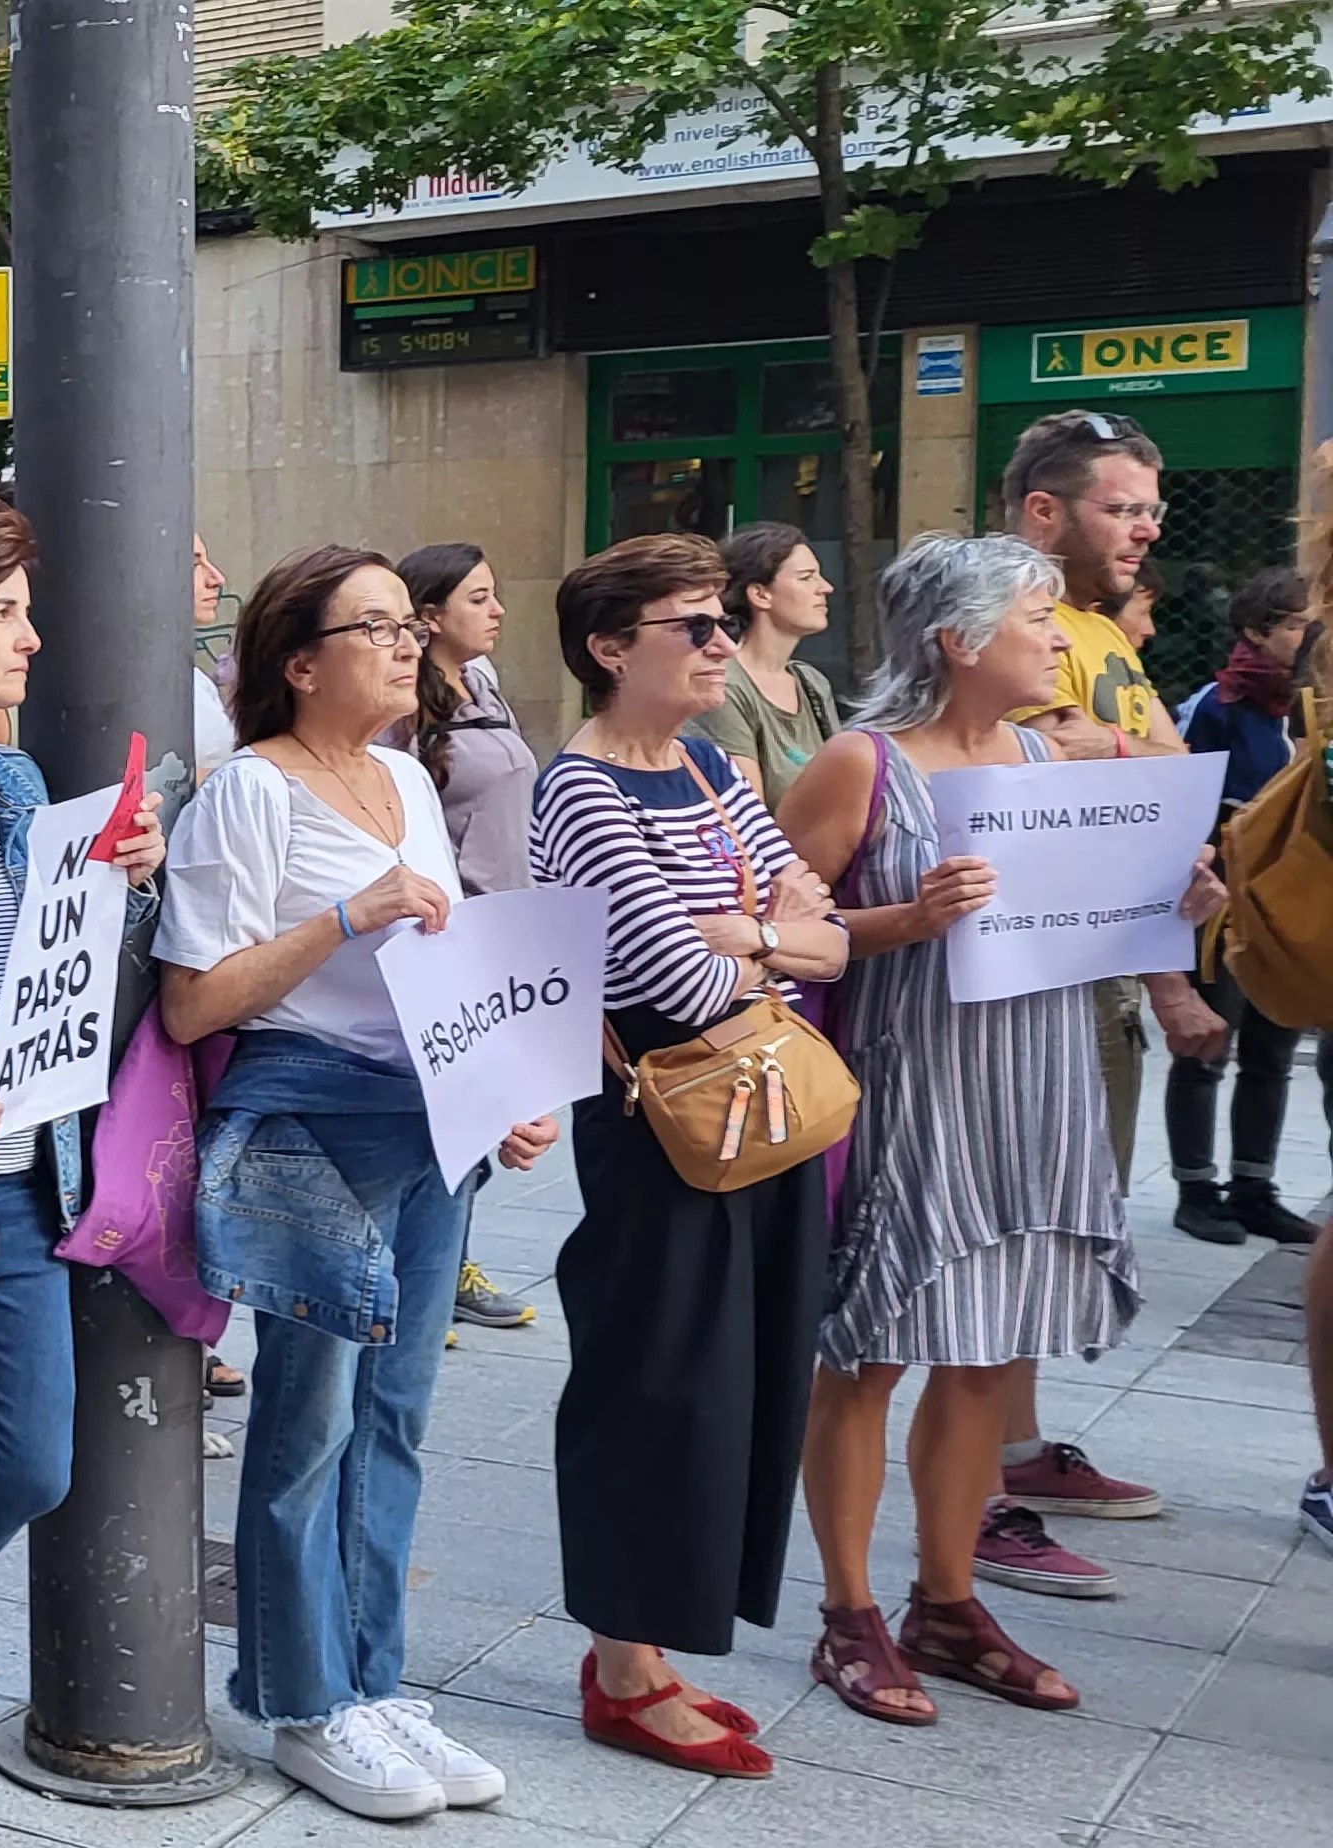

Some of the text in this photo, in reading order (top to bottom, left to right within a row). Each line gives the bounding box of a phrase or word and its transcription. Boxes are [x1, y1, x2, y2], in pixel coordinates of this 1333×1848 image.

[396, 252, 527, 292] ONCE
[400, 332, 470, 353] 54084
[1094, 331, 1232, 368] ONCE
[966, 802, 1162, 834] #NI UNA MENOS
[53, 833, 100, 886] NI
[39, 891, 88, 951] UN
[1041, 912, 1081, 929] nos
[11, 948, 92, 1027] PASO
[419, 965, 571, 1078] #SeAcabó
